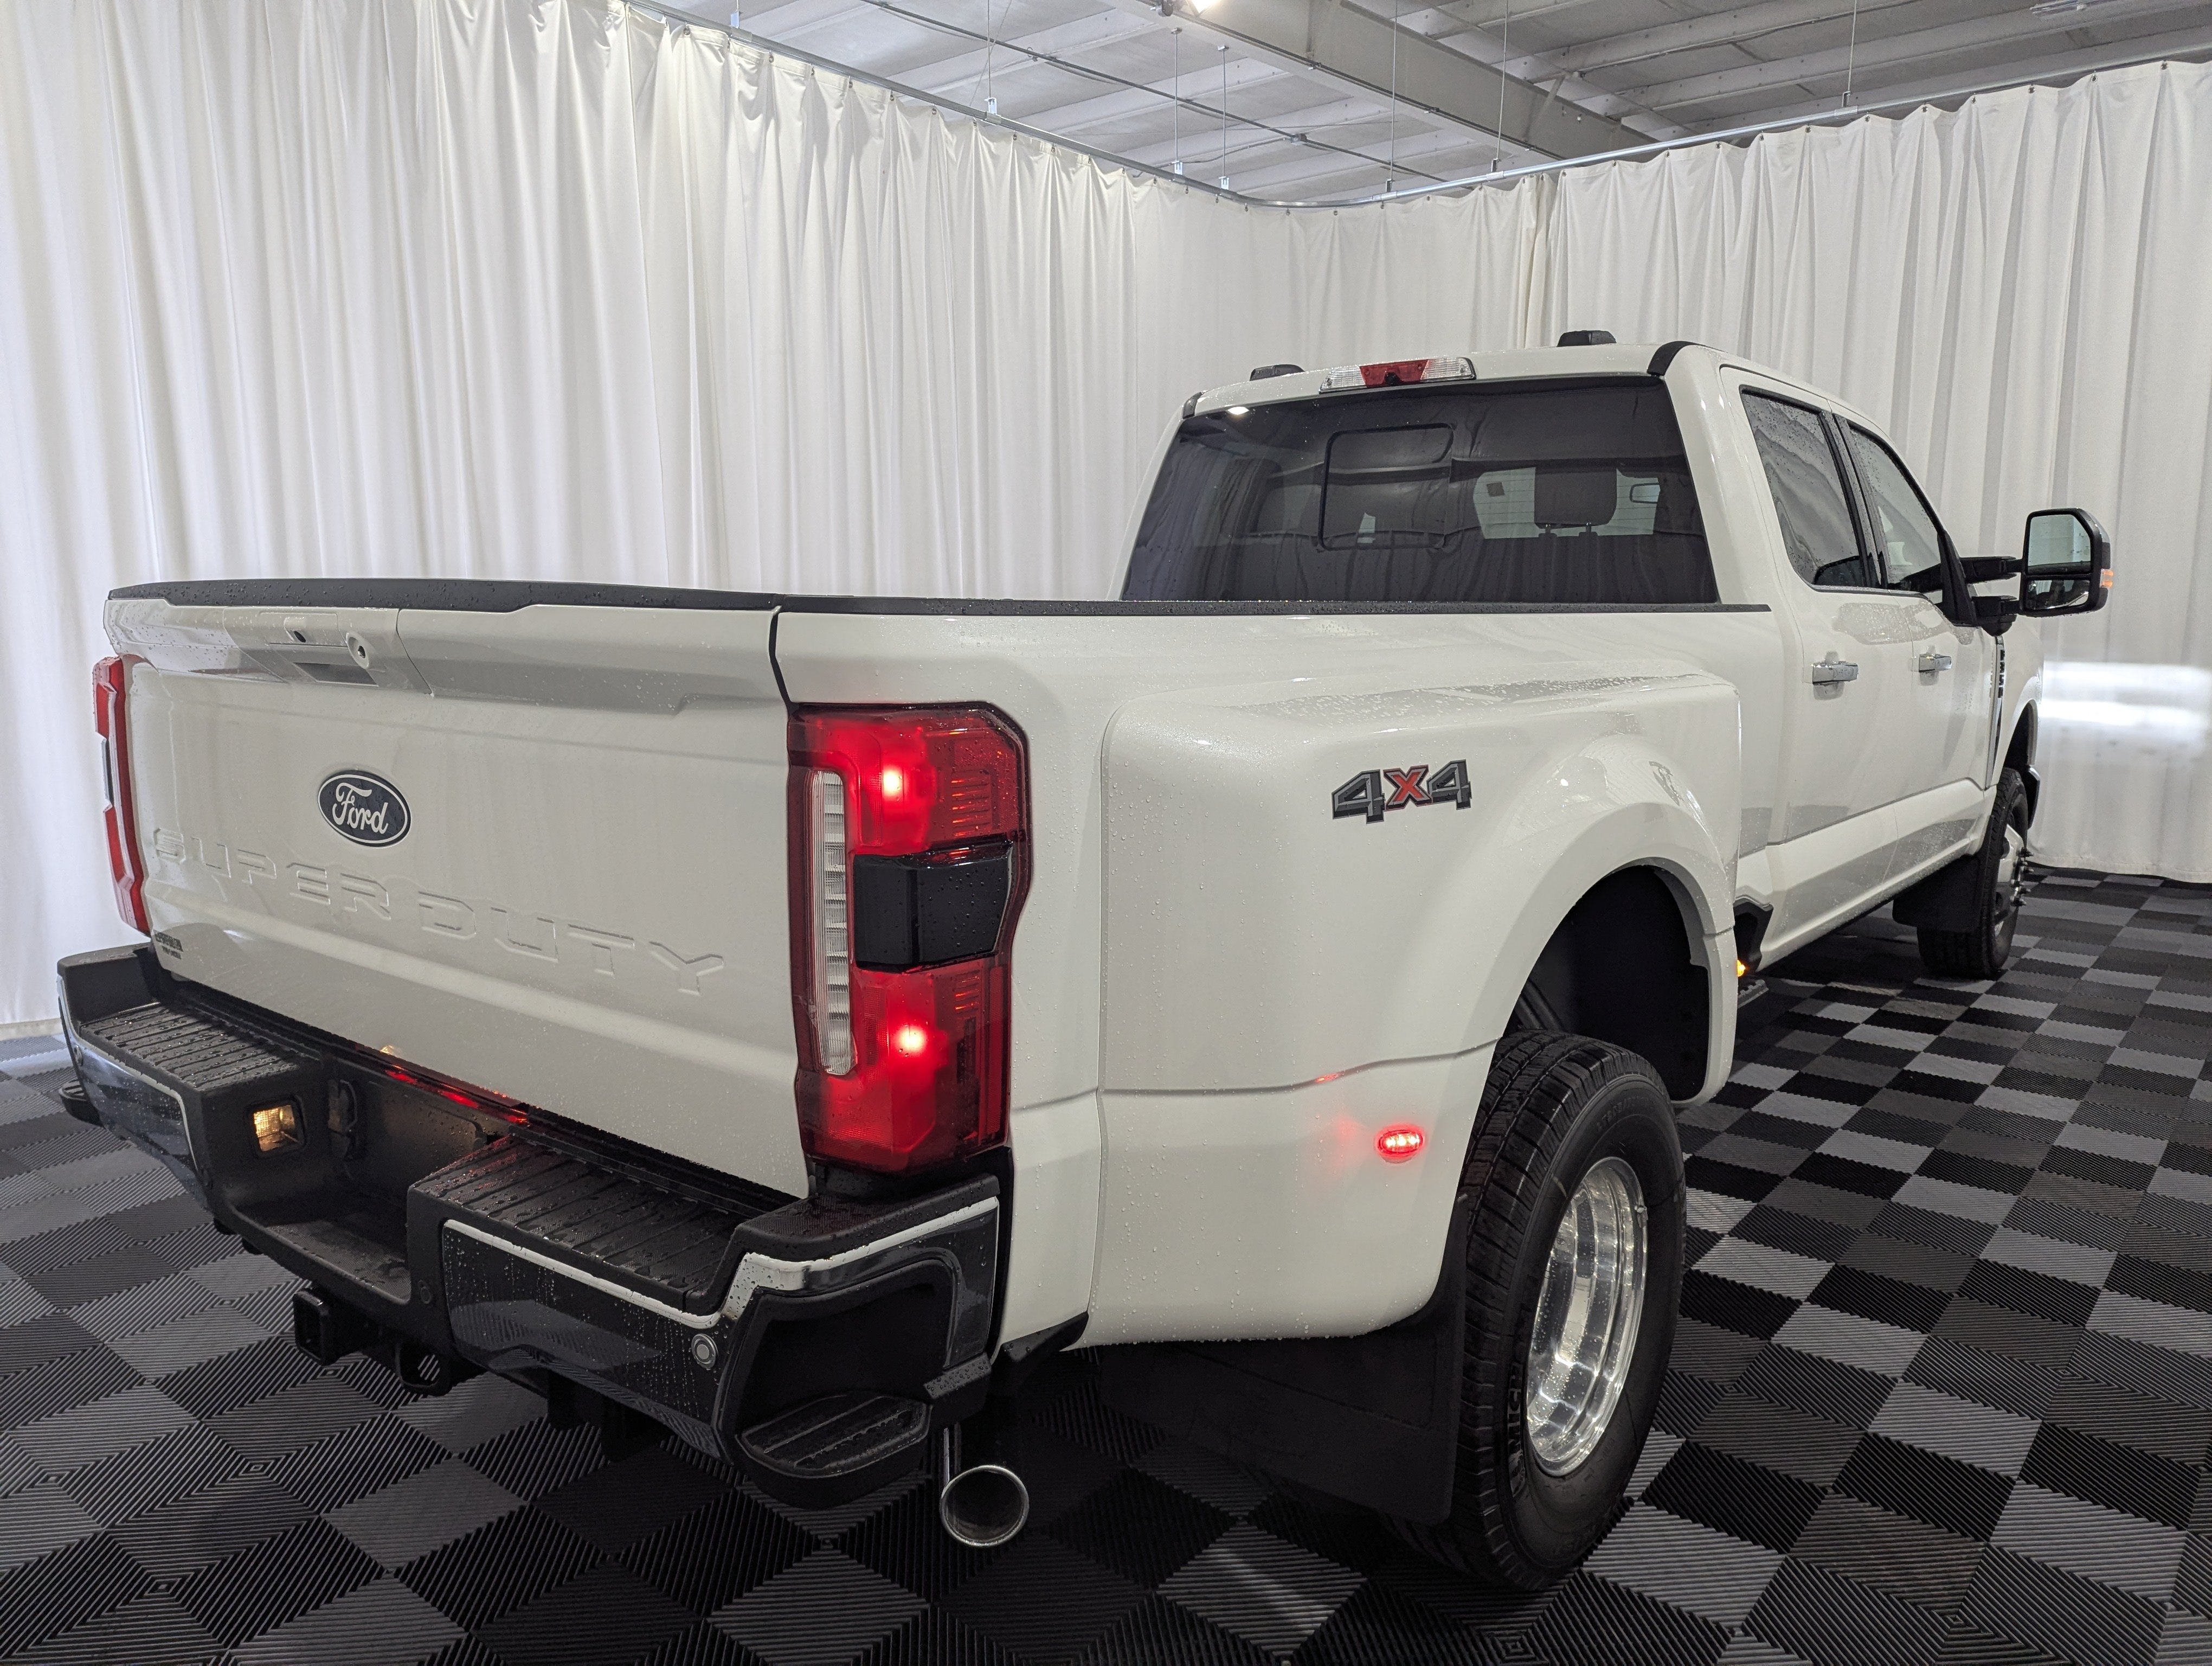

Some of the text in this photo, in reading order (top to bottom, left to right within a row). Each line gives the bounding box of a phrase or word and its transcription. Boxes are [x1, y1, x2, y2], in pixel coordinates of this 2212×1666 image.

[331, 781, 389, 835] Ford
[153, 827, 724, 996] SUPER DUTY
